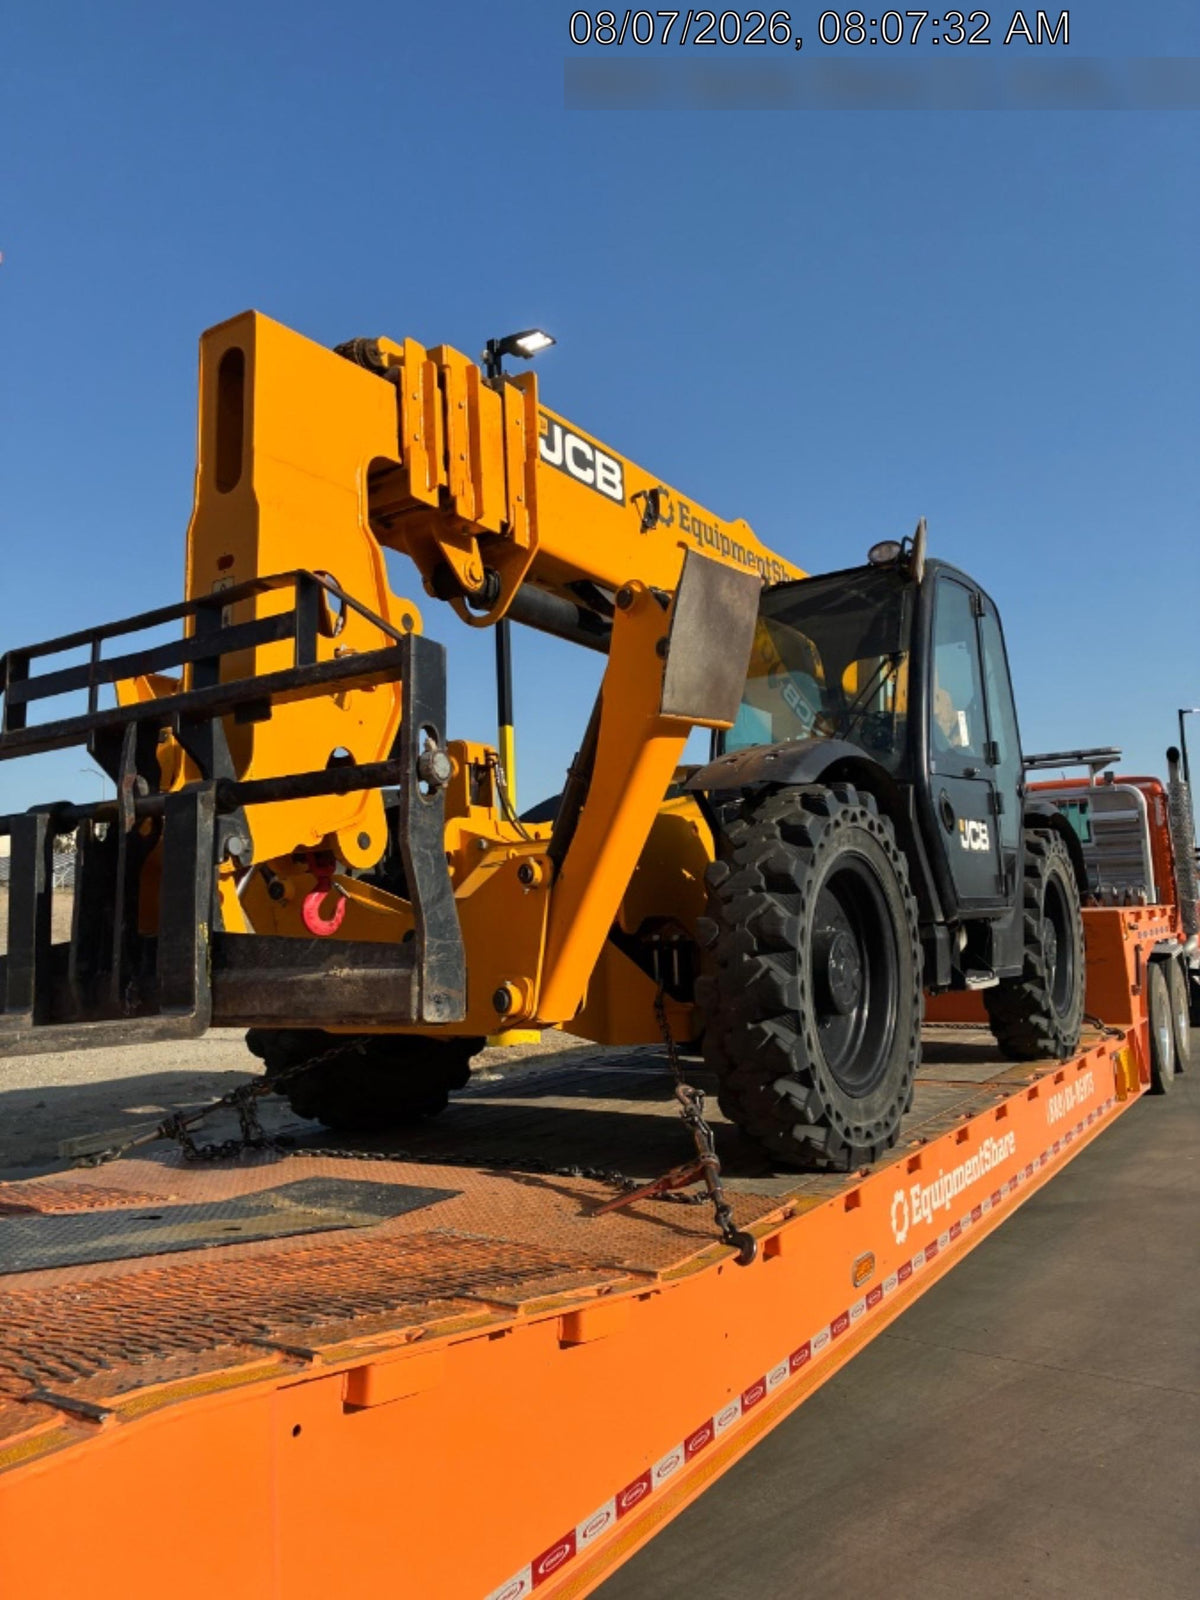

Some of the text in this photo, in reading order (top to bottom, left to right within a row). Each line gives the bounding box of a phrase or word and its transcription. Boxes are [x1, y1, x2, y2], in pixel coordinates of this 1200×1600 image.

[539, 424, 623, 501] JCB
[959, 818, 990, 851] JCB
[910, 1131, 1016, 1225] EquipmentShare
